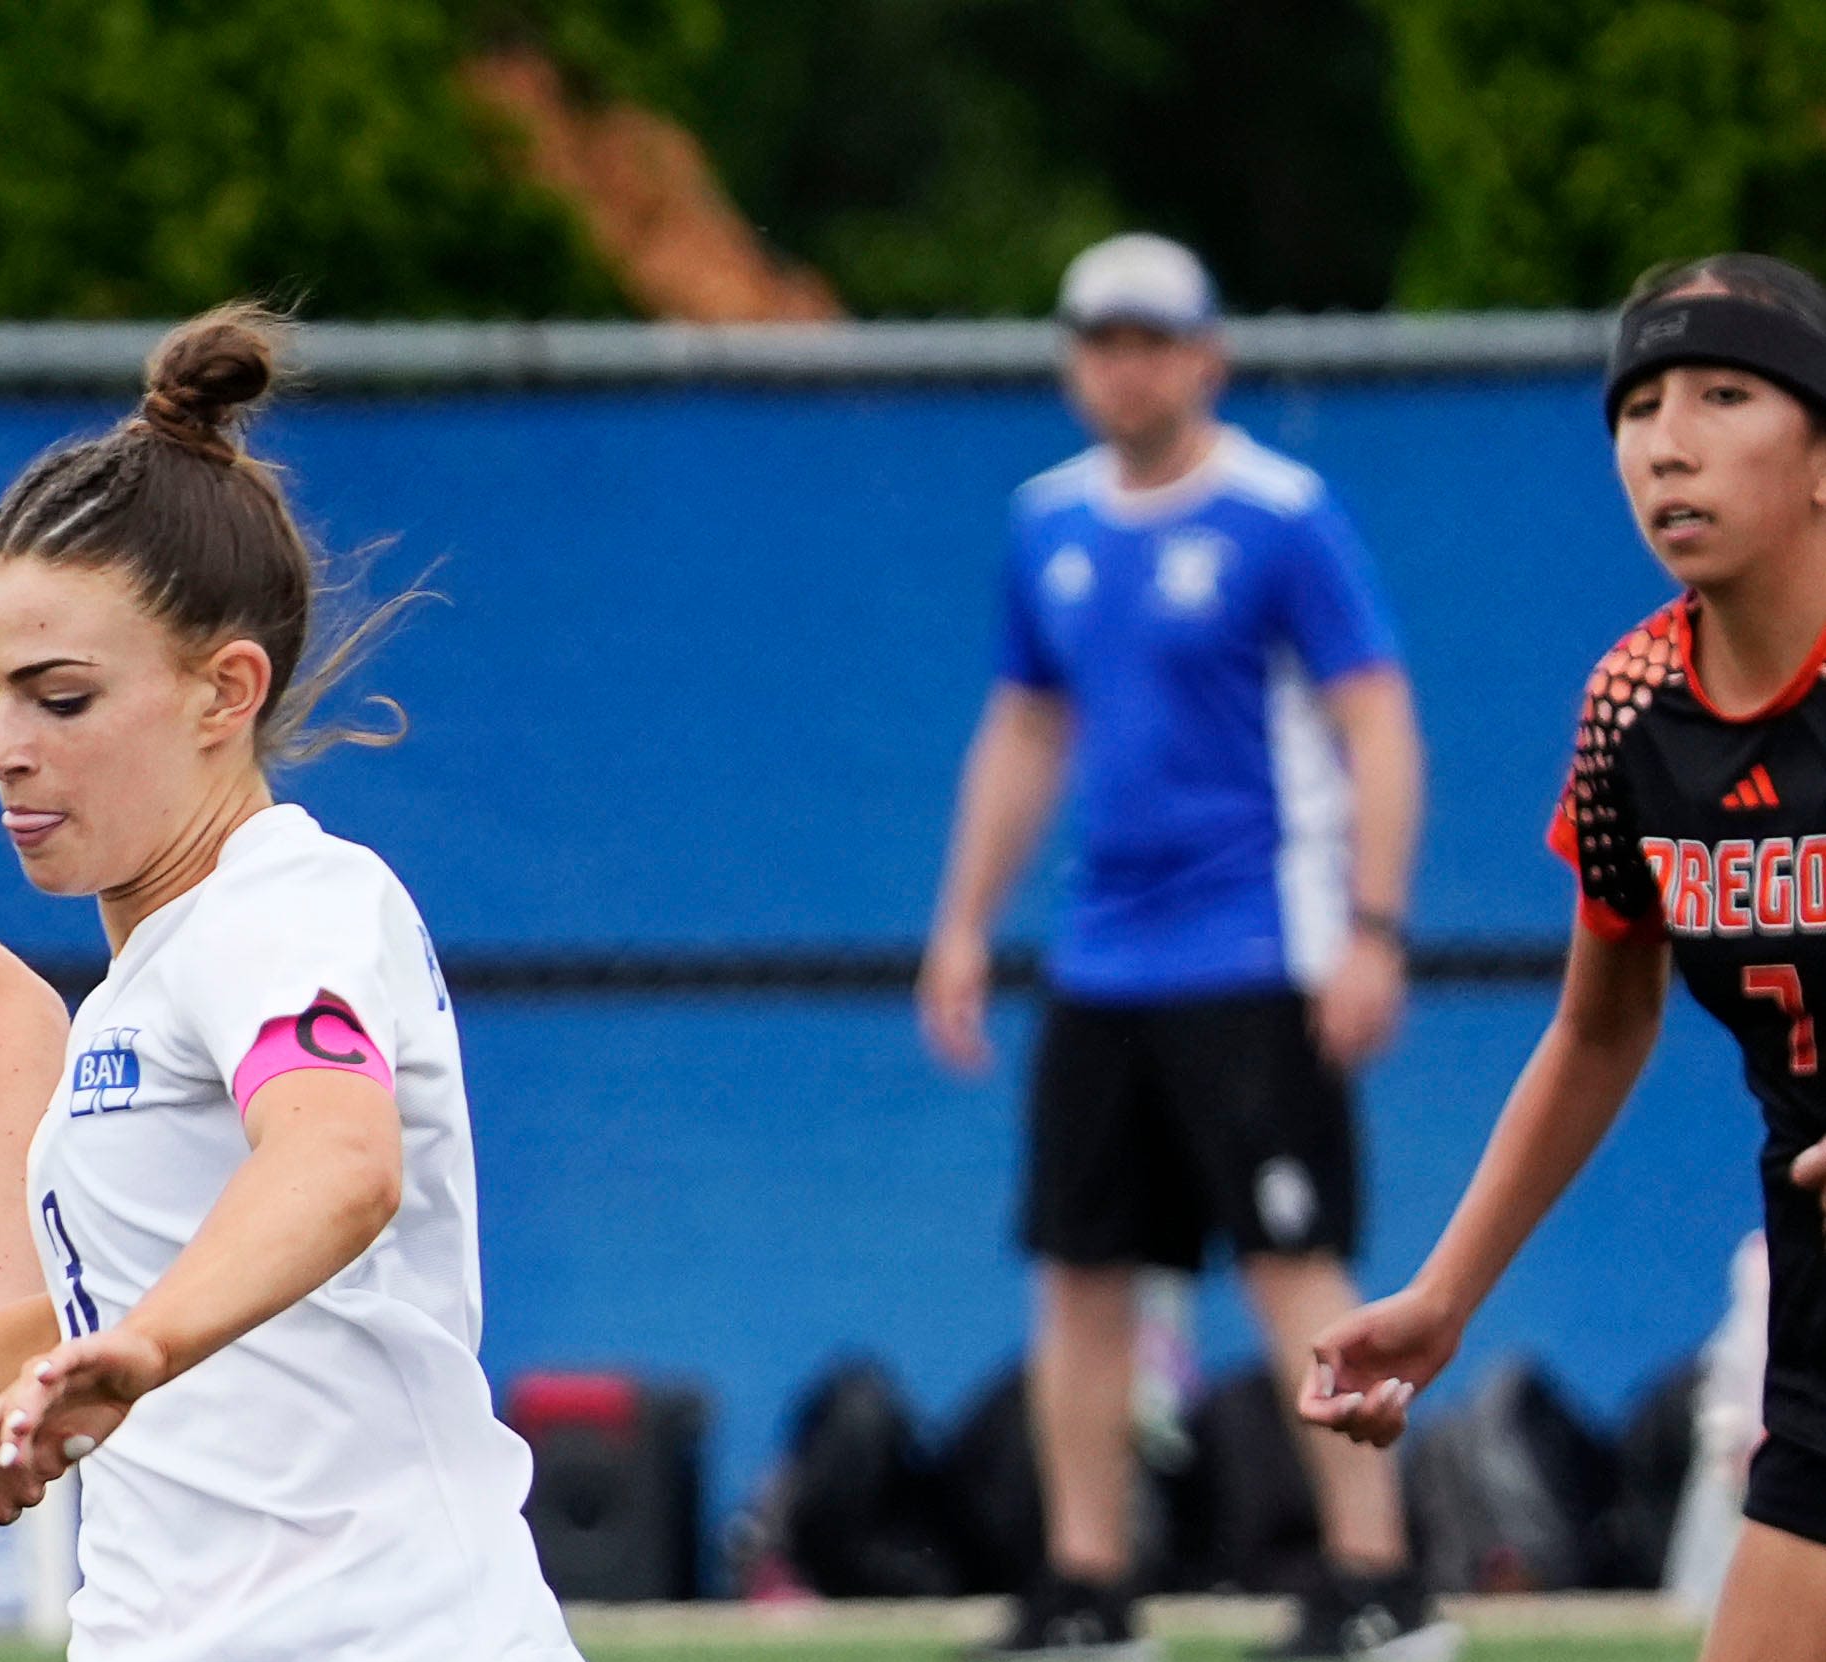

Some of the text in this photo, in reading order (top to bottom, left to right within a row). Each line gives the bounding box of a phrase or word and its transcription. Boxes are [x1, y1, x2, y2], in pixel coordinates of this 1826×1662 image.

[296, 1004, 367, 1065] C
[1742, 963, 1818, 1076] 7
[78, 1053, 126, 1089] BAY
